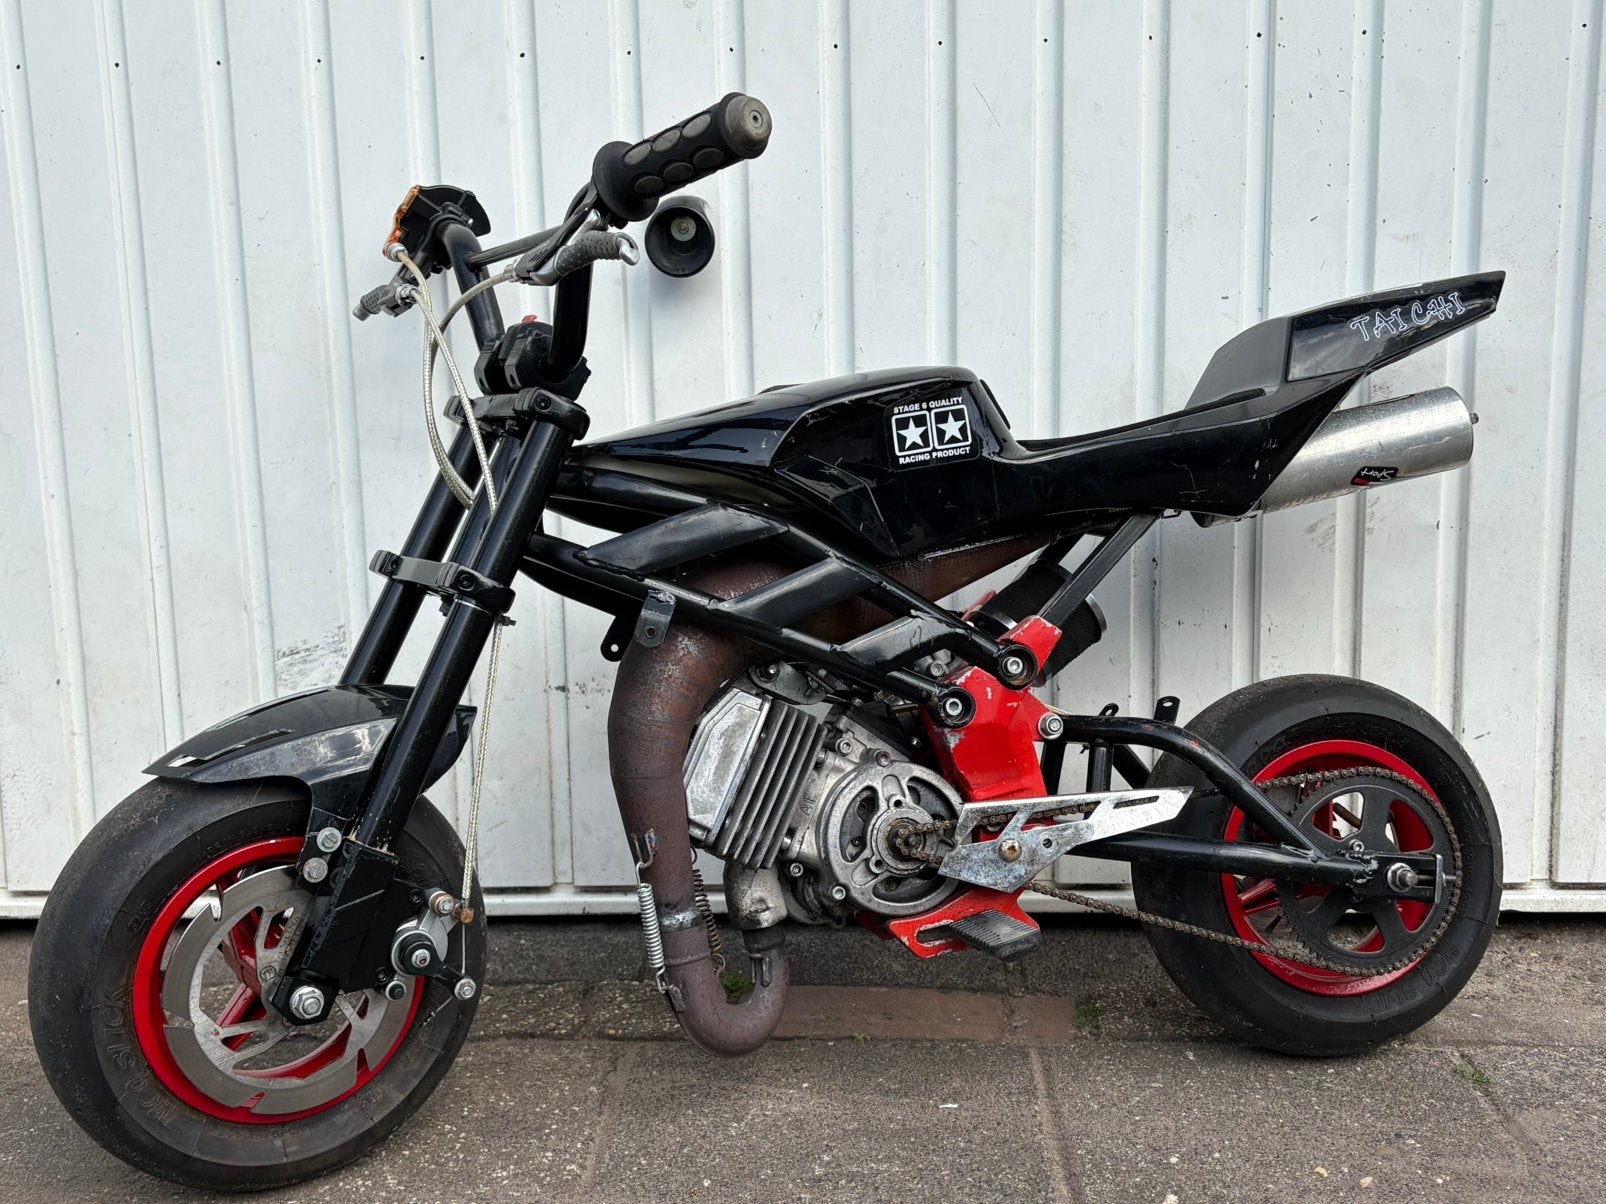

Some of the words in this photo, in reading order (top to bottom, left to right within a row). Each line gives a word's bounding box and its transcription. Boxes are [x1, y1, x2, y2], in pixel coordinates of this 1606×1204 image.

[1349, 307, 1408, 342] TAI
[1410, 291, 1466, 326] CHI
[893, 404, 920, 413] STAGE
[929, 397, 963, 407] QUALITY
[899, 453, 930, 464] RACING
[932, 447, 971, 458] PRODUCT
[1360, 467, 1395, 481] Sport
